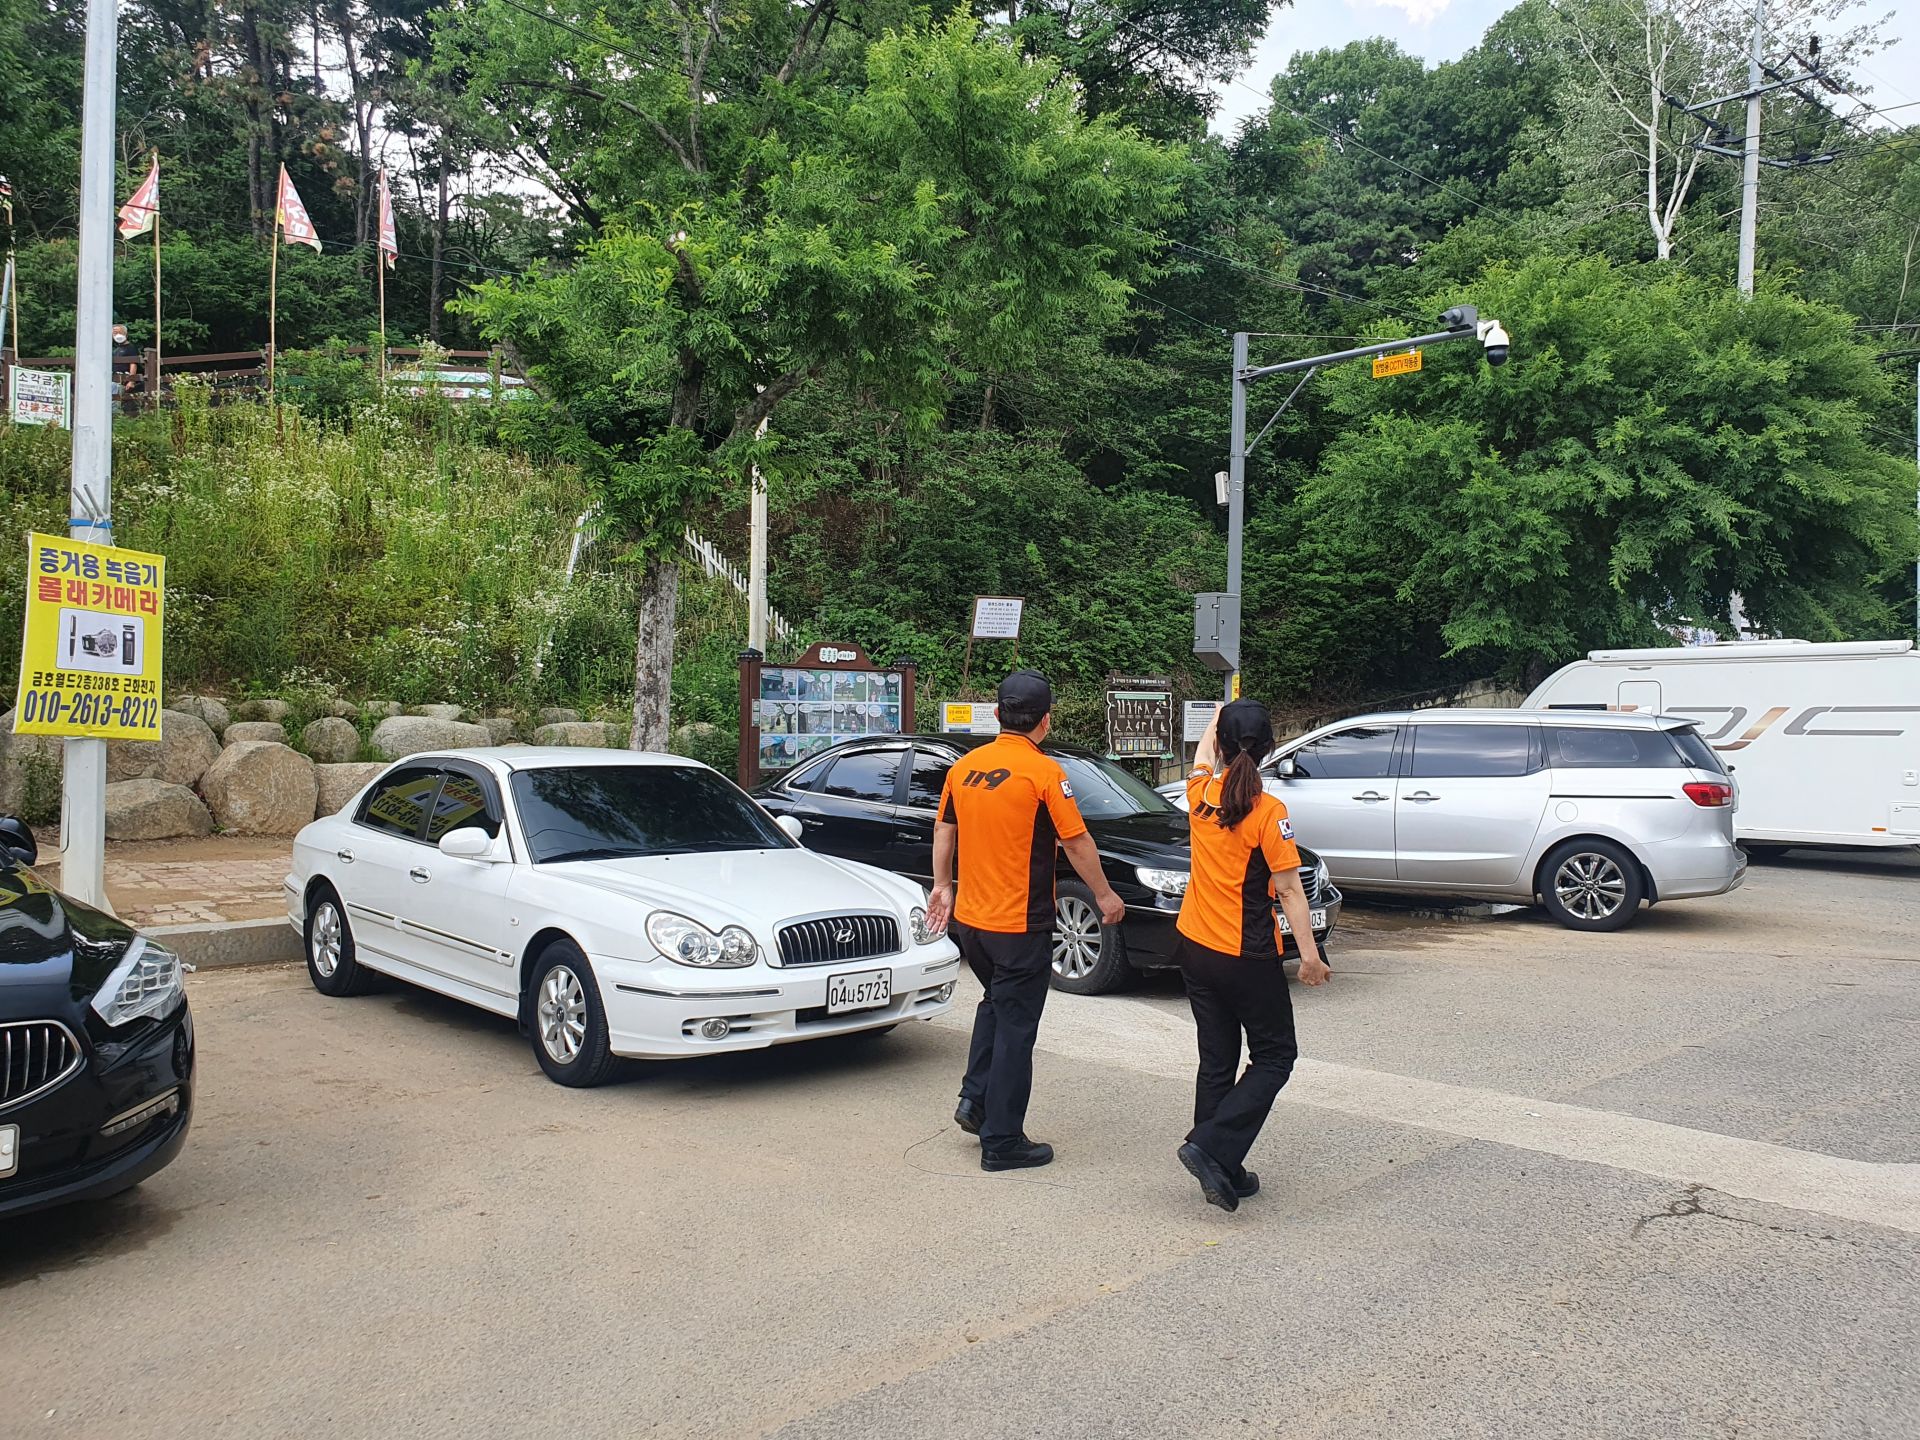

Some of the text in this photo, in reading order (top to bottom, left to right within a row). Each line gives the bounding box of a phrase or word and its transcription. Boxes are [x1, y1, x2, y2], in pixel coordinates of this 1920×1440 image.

[39, 547, 158, 588] 증거용 녹음기
[123, 677, 157, 695] 근화전자
[23, 689, 158, 729] 010-2613-8212
[962, 768, 1011, 791] 119
[830, 980, 889, 1007] 04나5723
